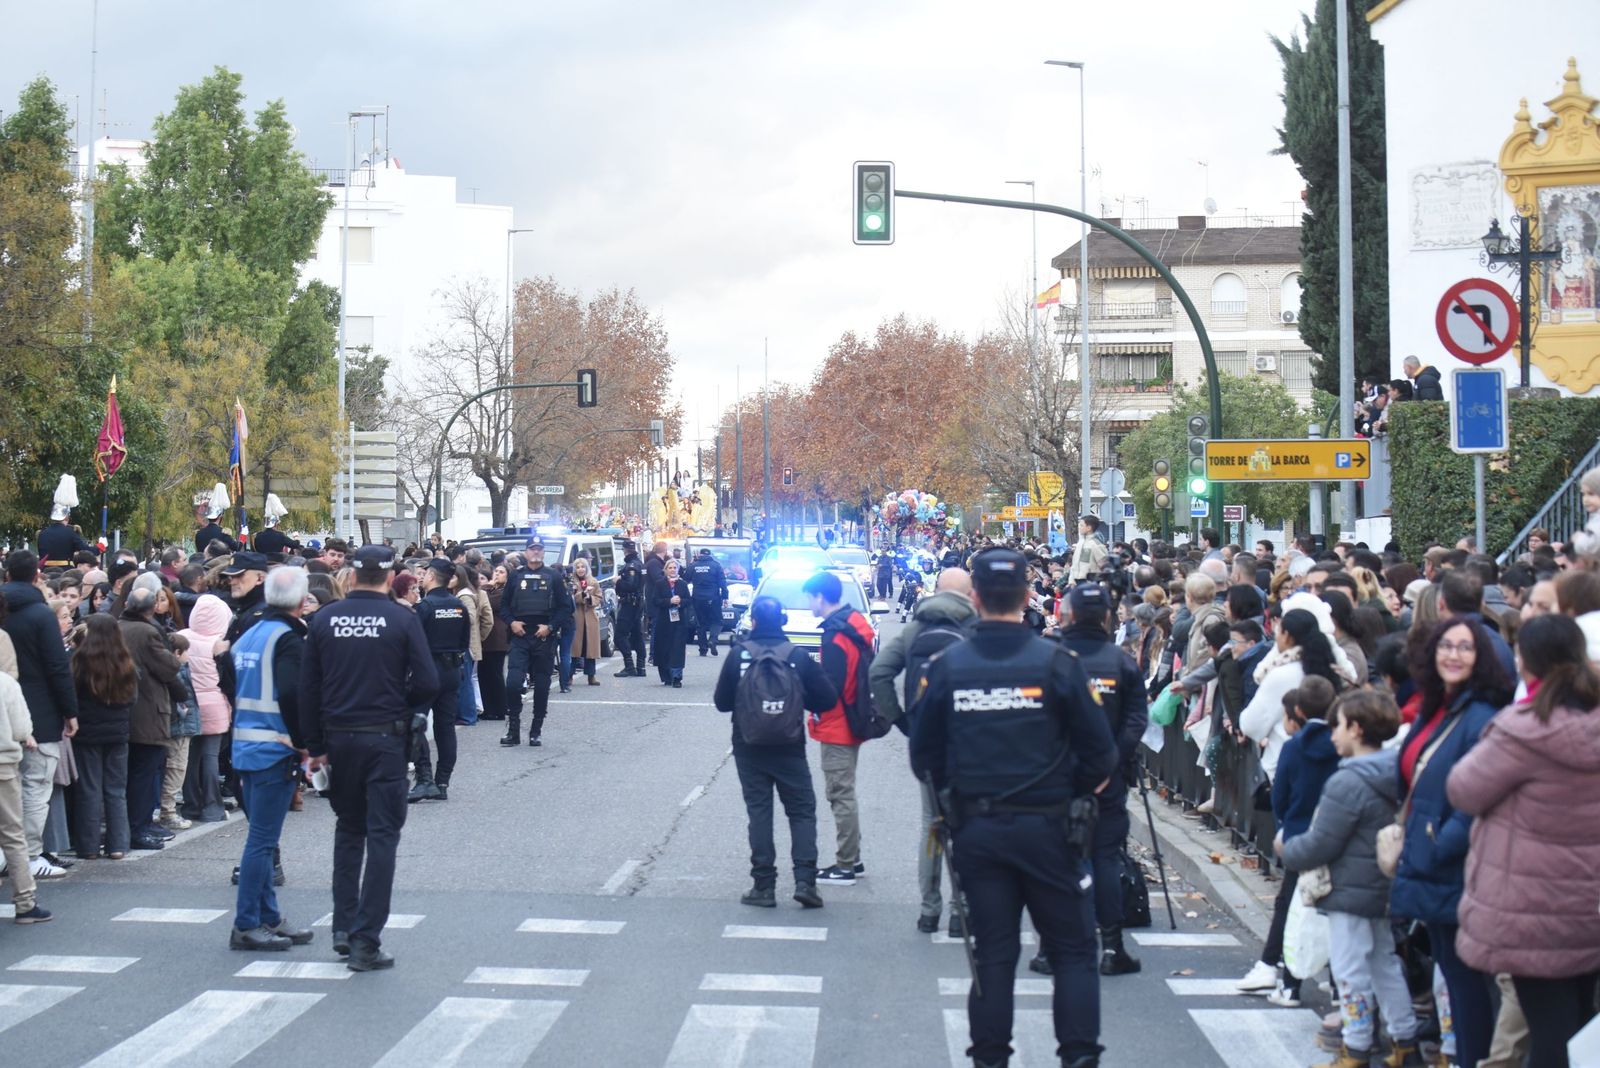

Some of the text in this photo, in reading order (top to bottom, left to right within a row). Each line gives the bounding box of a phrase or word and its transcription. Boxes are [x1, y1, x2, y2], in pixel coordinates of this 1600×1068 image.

[1209, 454, 1348, 466] TORRE DE LA BARCA P
[330, 616, 387, 627] POLICIA
[334, 626, 380, 638] LOCAL
[953, 687, 1023, 701] POLICIA
[954, 698, 1044, 712] NACIONAL
